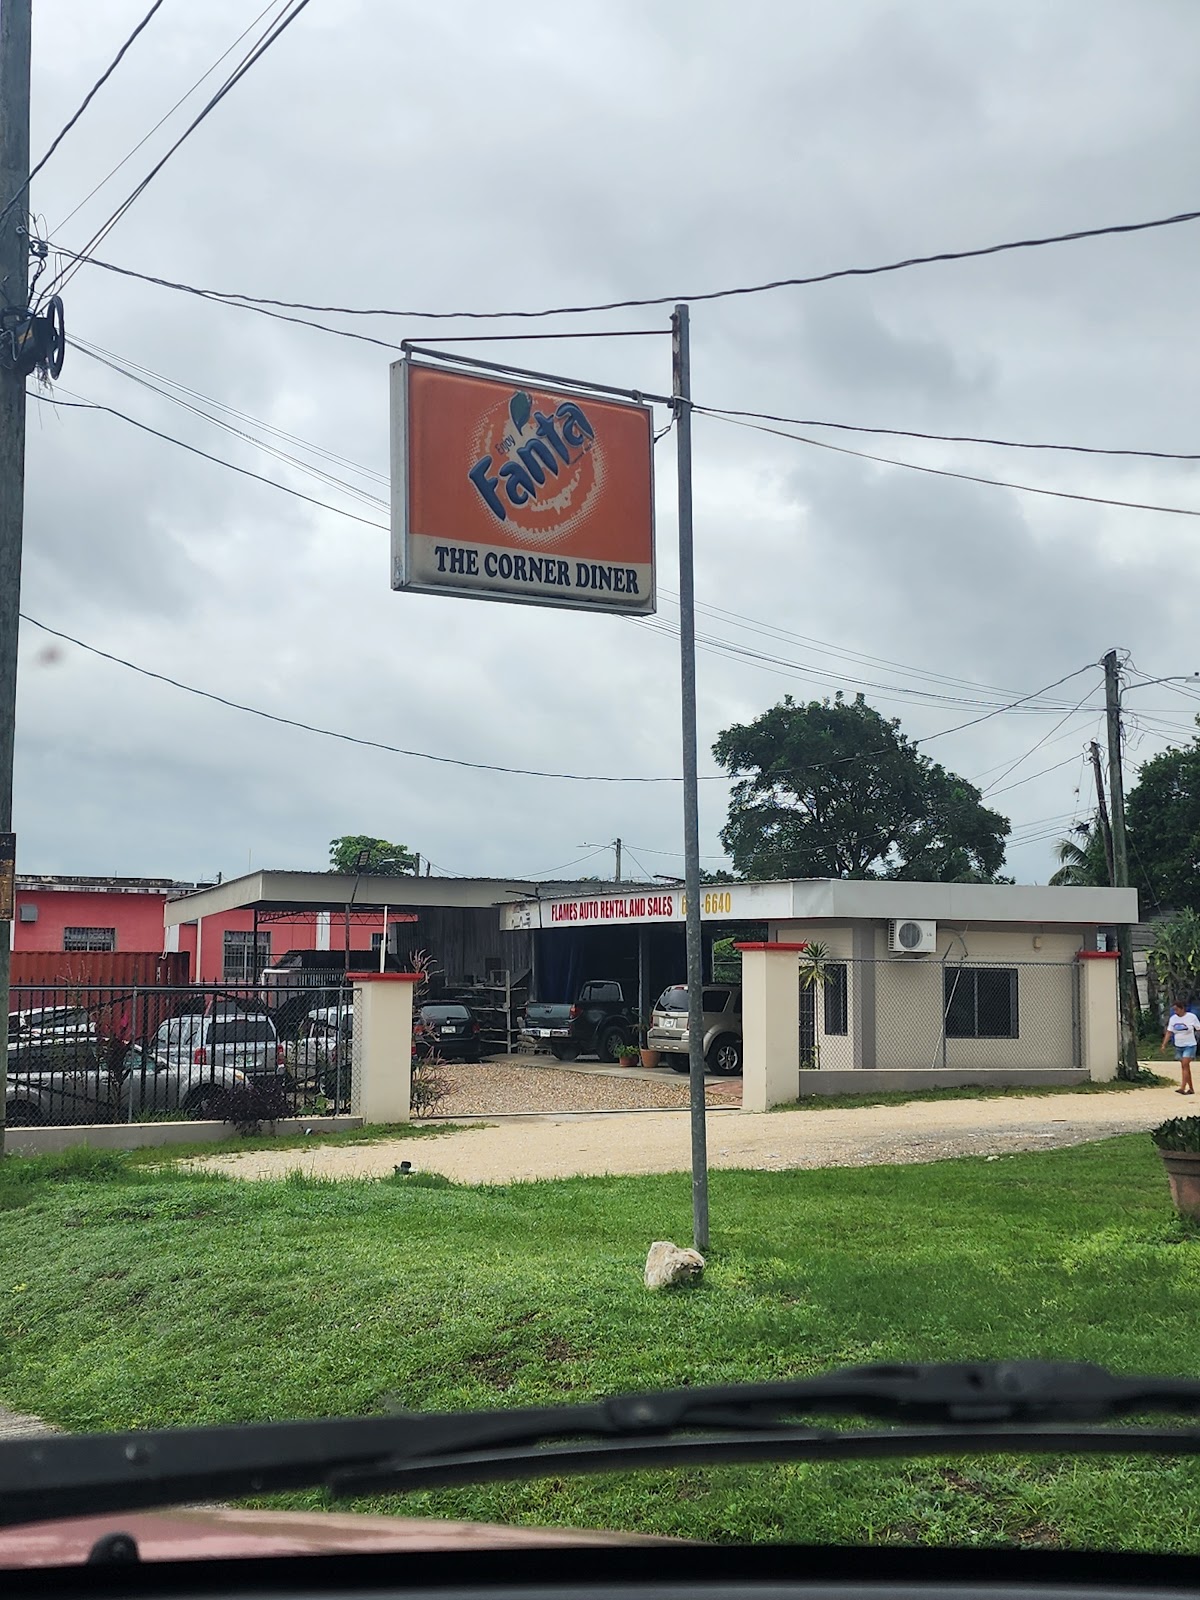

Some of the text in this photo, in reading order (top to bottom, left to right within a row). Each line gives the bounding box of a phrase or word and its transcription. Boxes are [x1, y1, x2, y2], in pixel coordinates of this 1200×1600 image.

[469, 402, 595, 521] Fanta
[495, 434, 516, 455] Enjoy
[435, 546, 640, 594] THE CORNER DINER
[551, 903, 578, 921] FLAMES
[579, 901, 598, 920] AUTO
[600, 899, 628, 919] RENTAL
[629, 898, 646, 917] AND
[647, 896, 673, 916] SALES
